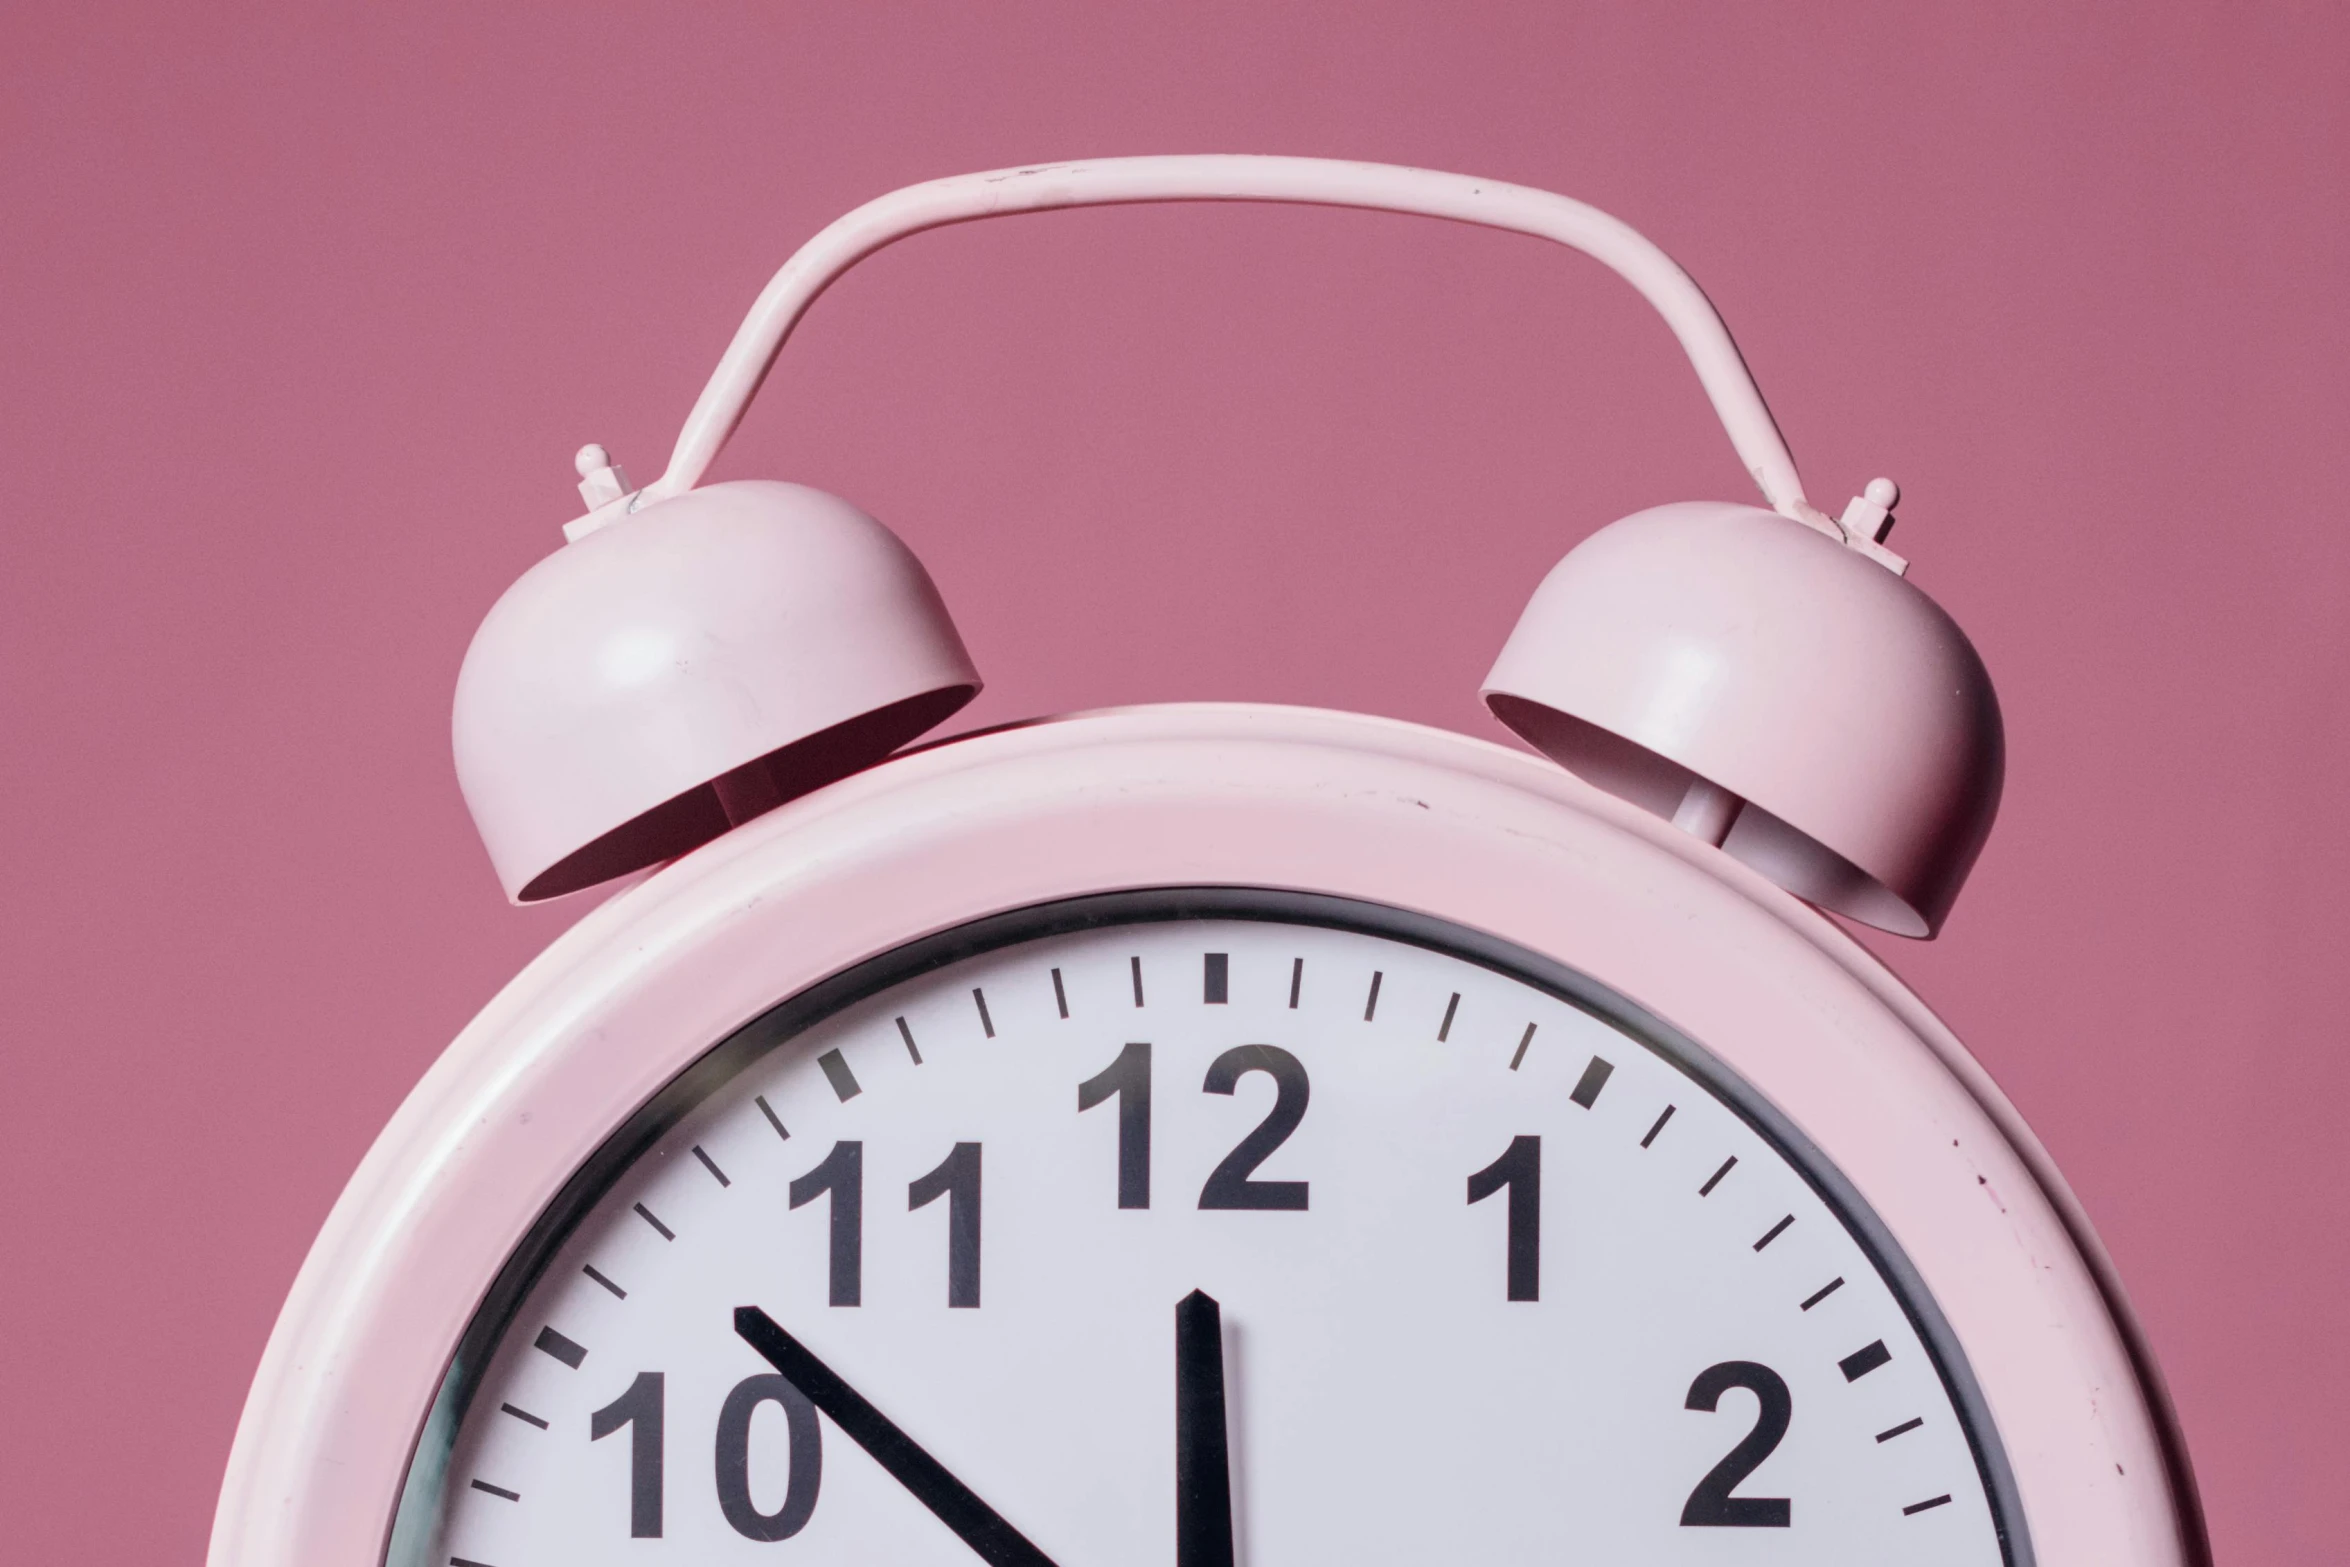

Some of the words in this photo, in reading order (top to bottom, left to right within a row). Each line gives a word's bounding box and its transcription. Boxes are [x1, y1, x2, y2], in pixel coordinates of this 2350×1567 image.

[1079, 1043, 1309, 1211] 12
[789, 1140, 982, 1309] 11
[1467, 1135, 1541, 1302] 1
[591, 1371, 823, 1542] 10
[1679, 1360, 1792, 1528] 2
